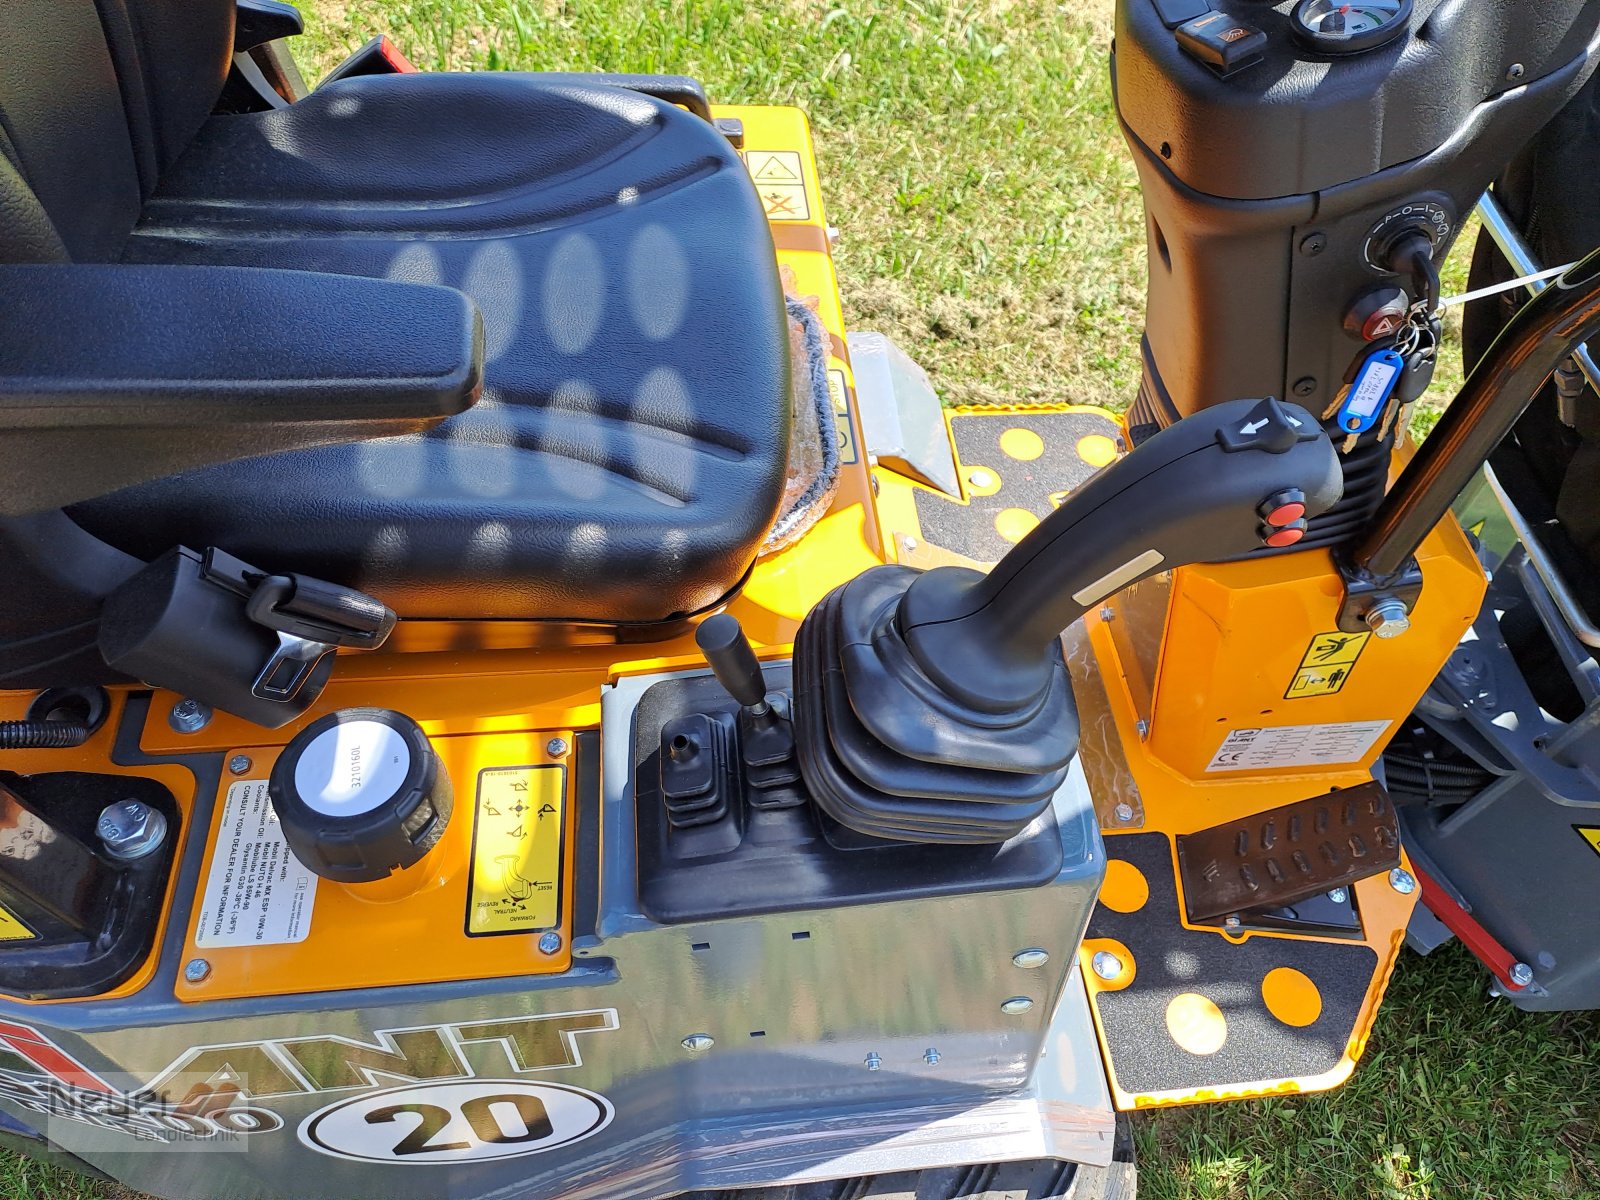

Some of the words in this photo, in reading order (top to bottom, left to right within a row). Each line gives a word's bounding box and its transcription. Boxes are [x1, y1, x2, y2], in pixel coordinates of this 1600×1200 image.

[351, 745, 361, 788] 3210160L
[1218, 752, 1244, 762] CE
[239, 786, 251, 816] CONSULT
[252, 785, 265, 814] Coolants:
[235, 818, 244, 837] YOUR
[268, 815, 277, 826] Oil:
[257, 828, 265, 839] Oil:
[228, 839, 240, 867] DEALER
[239, 843, 253, 874] Glysantin
[250, 842, 262, 872] Mobilube
[262, 842, 271, 860] Mobil
[271, 842, 280, 860] Mobil
[224, 869, 233, 883] FOR
[248, 875, 255, 883] LS
[258, 862, 267, 881] NUTO
[266, 861, 277, 883] Delvac
[279, 866, 288, 882] with:
[237, 876, 246, 889] G30
[264, 885, 272, 896] MX
[242, 885, 253, 910] 85W-90
[254, 890, 261, 898] 46
[213, 885, 230, 936] INFORMATION
[261, 898, 270, 912] ESP
[255, 915, 267, 940] 10W-30
[287, 913, 295, 938] information
[364, 1094, 553, 1155] 20
